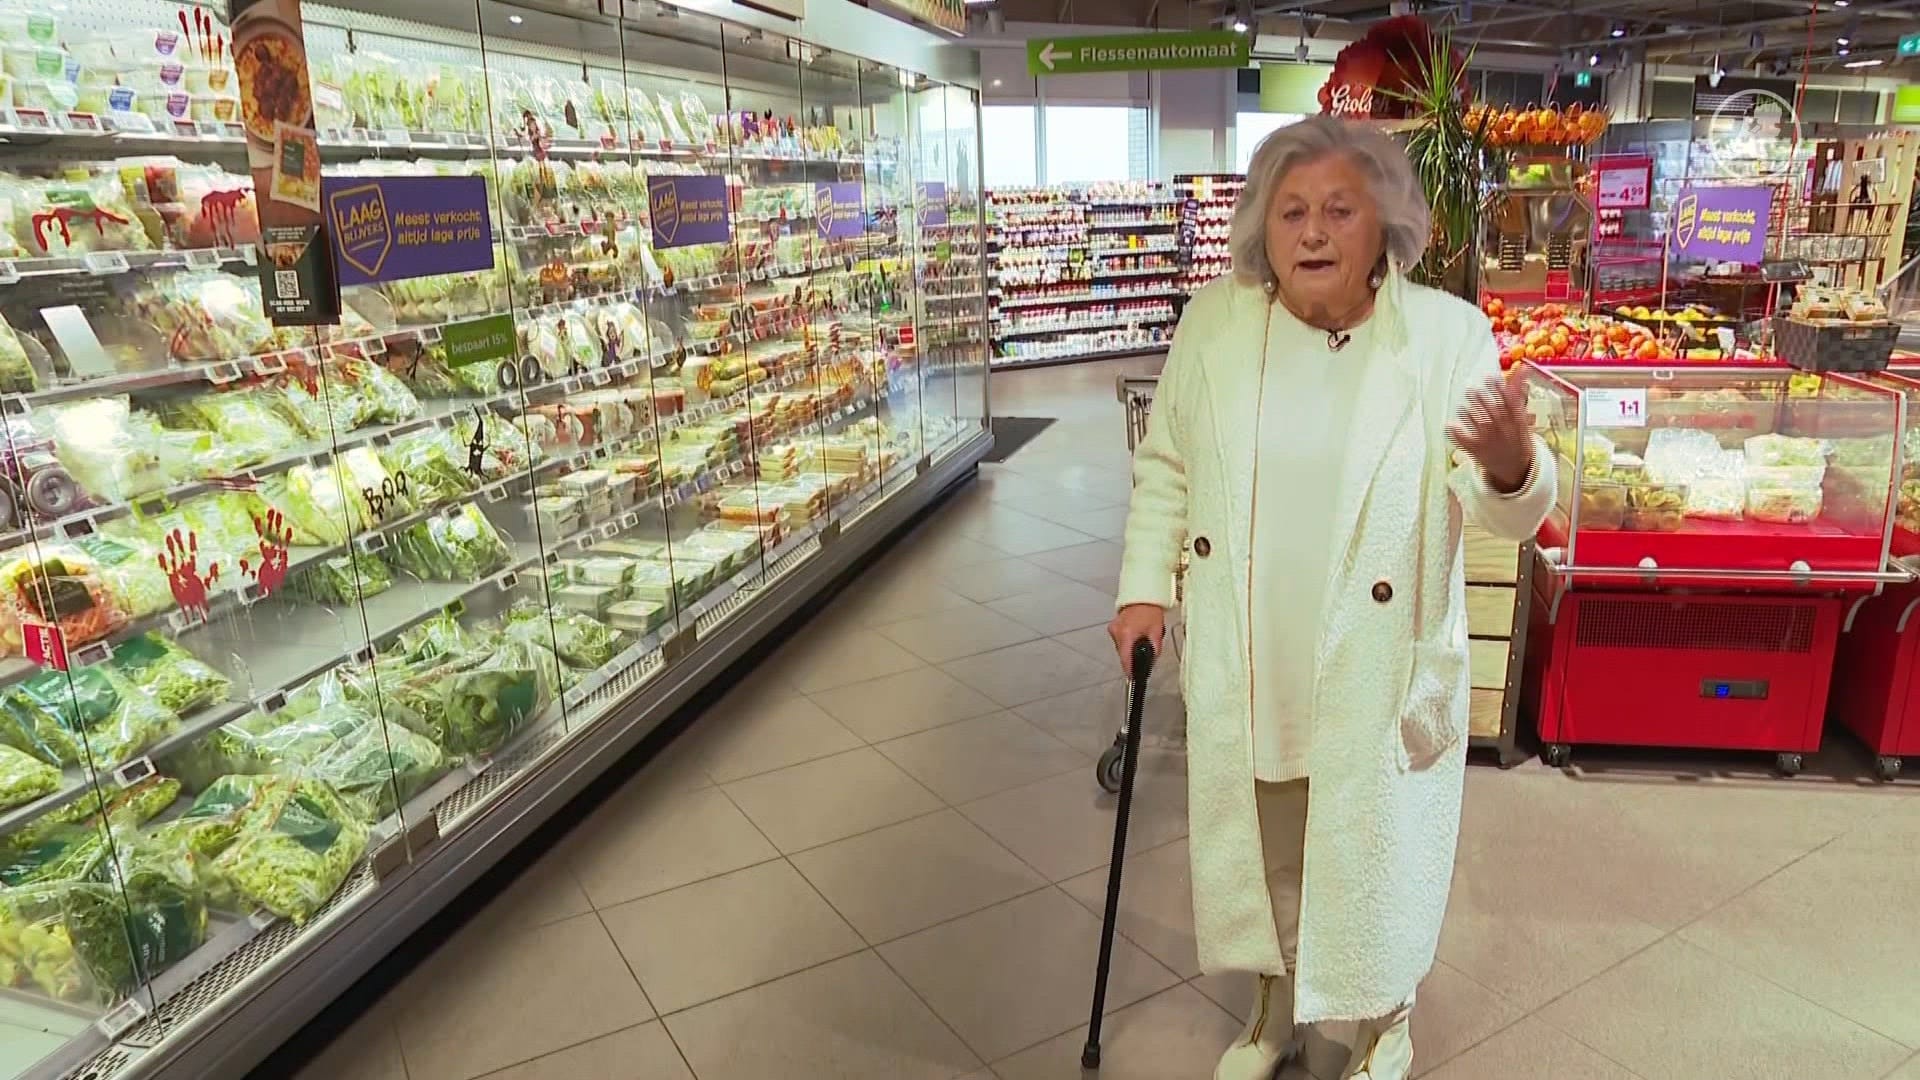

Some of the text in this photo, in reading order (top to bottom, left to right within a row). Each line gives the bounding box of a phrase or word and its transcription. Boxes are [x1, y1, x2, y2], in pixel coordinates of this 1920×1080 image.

[1080, 42, 1237, 62] Flessenautomaat
[339, 199, 382, 230] LAAG
[395, 211, 431, 226] Meest
[397, 227, 481, 245] altijd lage prijs
[451, 334, 508, 353] bespaart 15%
[1619, 400, 1639, 415] 1+1
